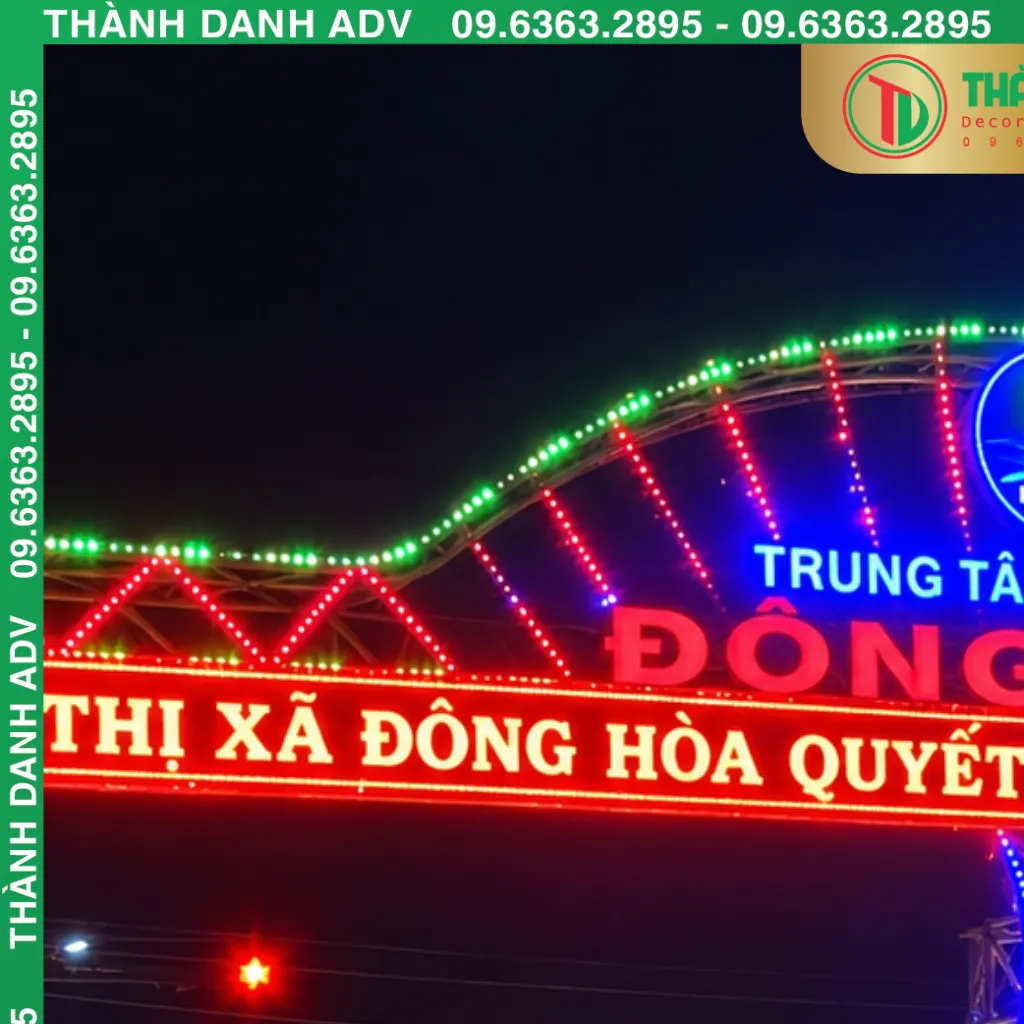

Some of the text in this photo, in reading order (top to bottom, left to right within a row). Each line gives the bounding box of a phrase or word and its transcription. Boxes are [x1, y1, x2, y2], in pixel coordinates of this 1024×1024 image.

[753, 544, 942, 599] TRUNG
[43, 694, 186, 773] THỊ
[215, 691, 334, 764] XÃ
[360, 697, 577, 776] ĐÔNG
[606, 711, 763, 786] HÒA
